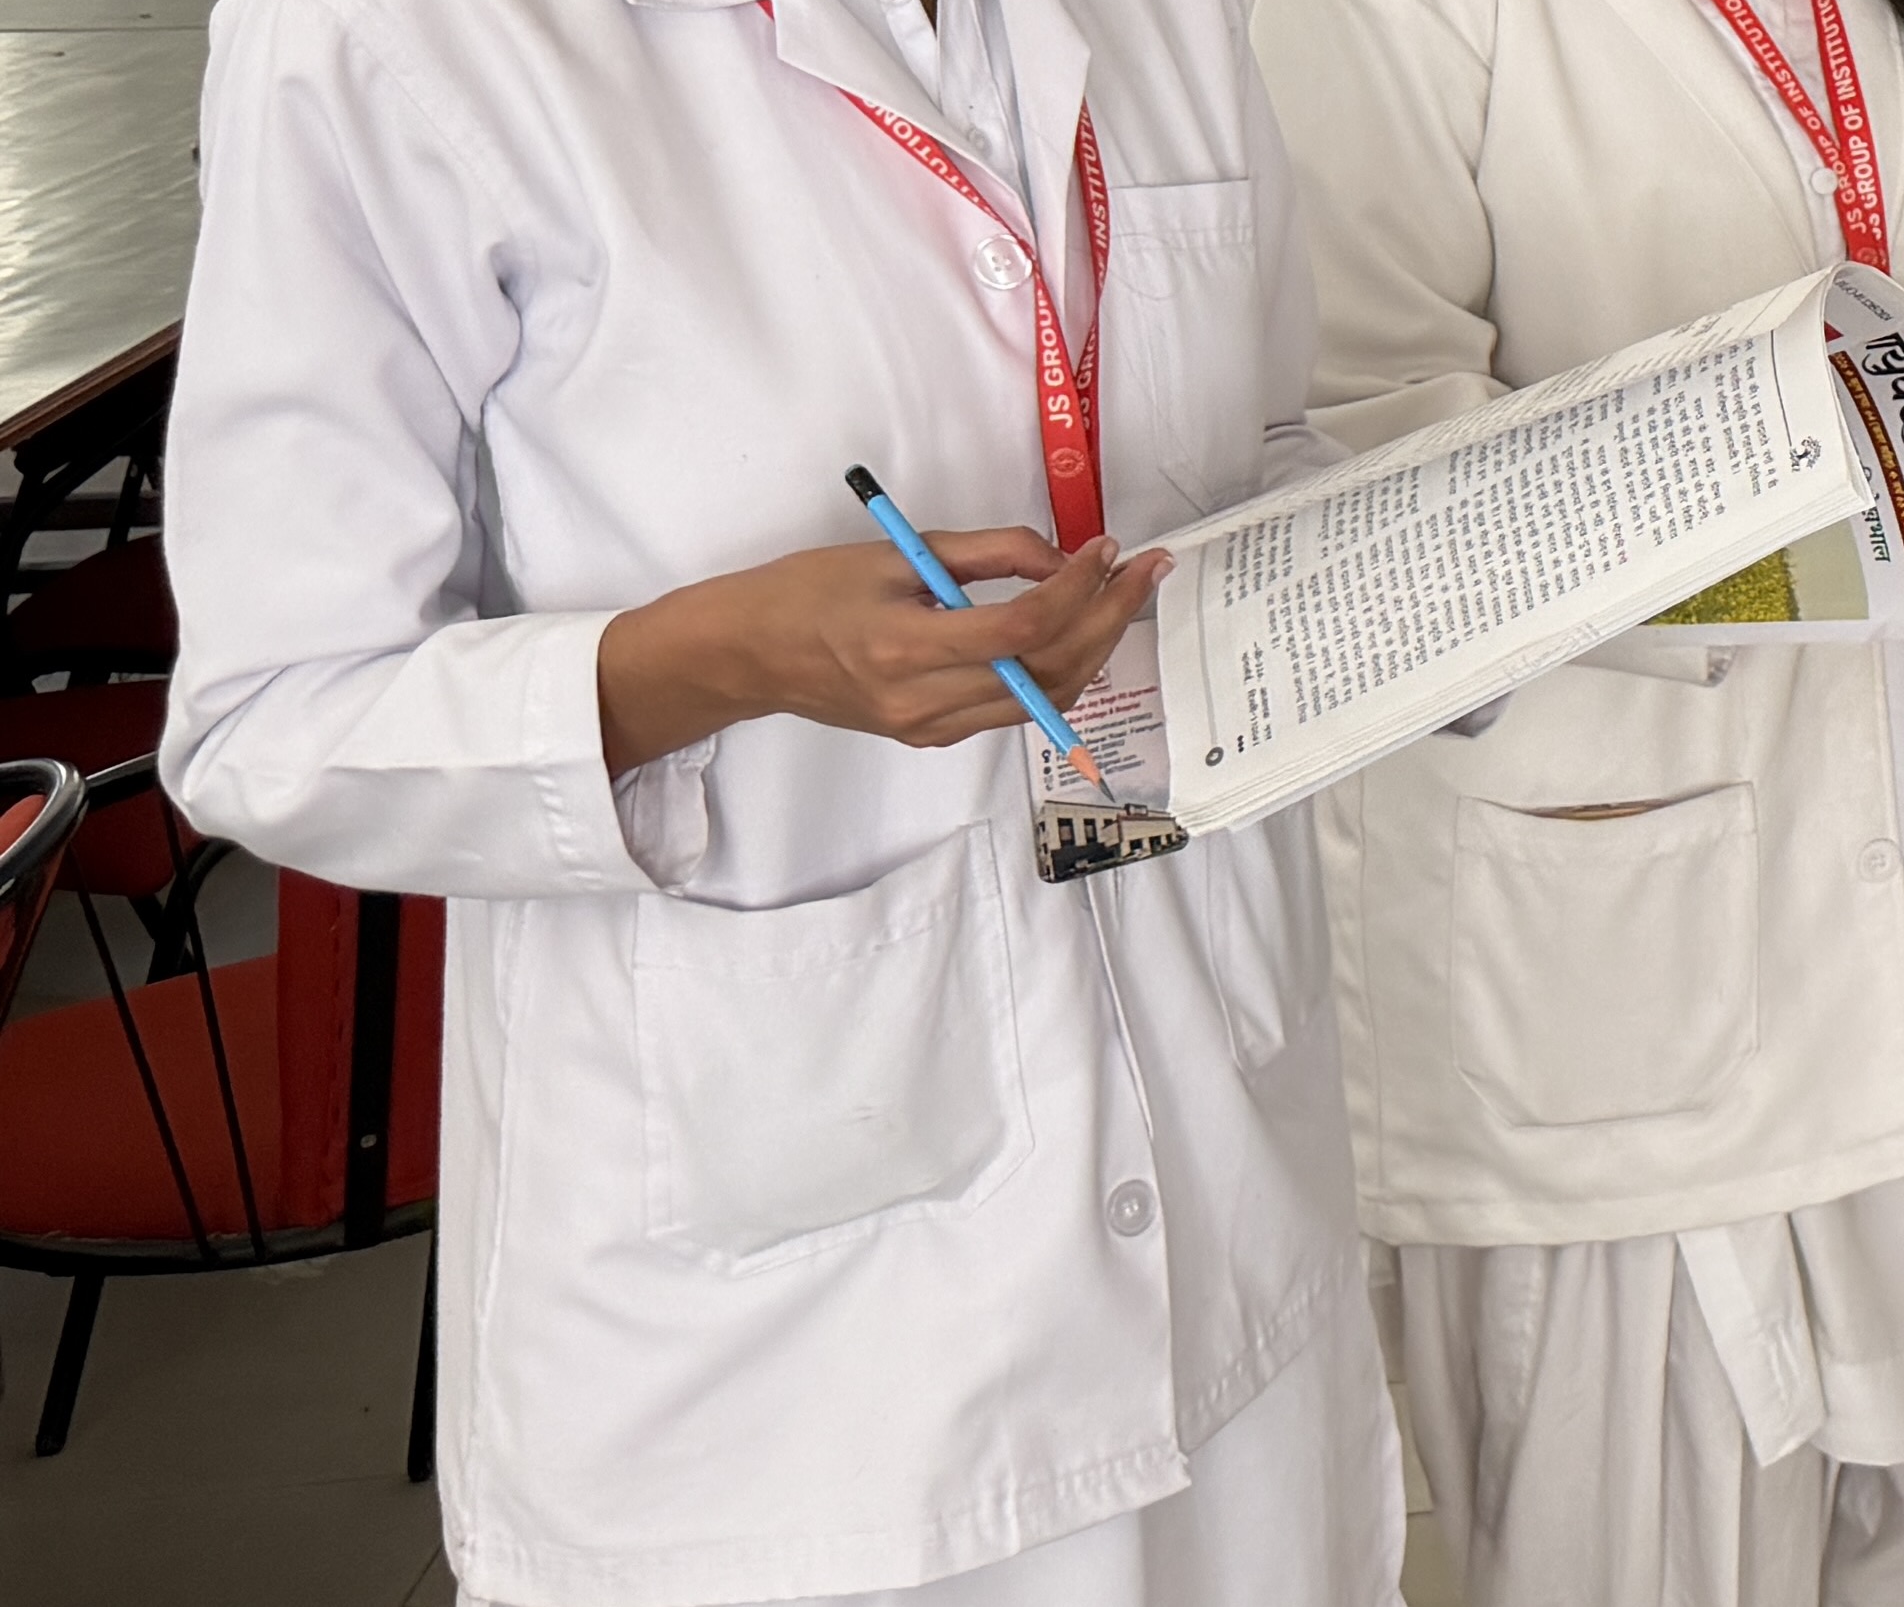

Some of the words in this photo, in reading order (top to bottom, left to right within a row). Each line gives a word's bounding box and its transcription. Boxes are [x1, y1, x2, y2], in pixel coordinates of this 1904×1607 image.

[1799, 105, 1821, 131] OF
[1840, 103, 1863, 128] OF
[1818, 134, 1857, 199] GROUP
[1849, 135, 1878, 210] GROUP
[1847, 209, 1867, 234] JS
[1048, 397, 1073, 429] JS
